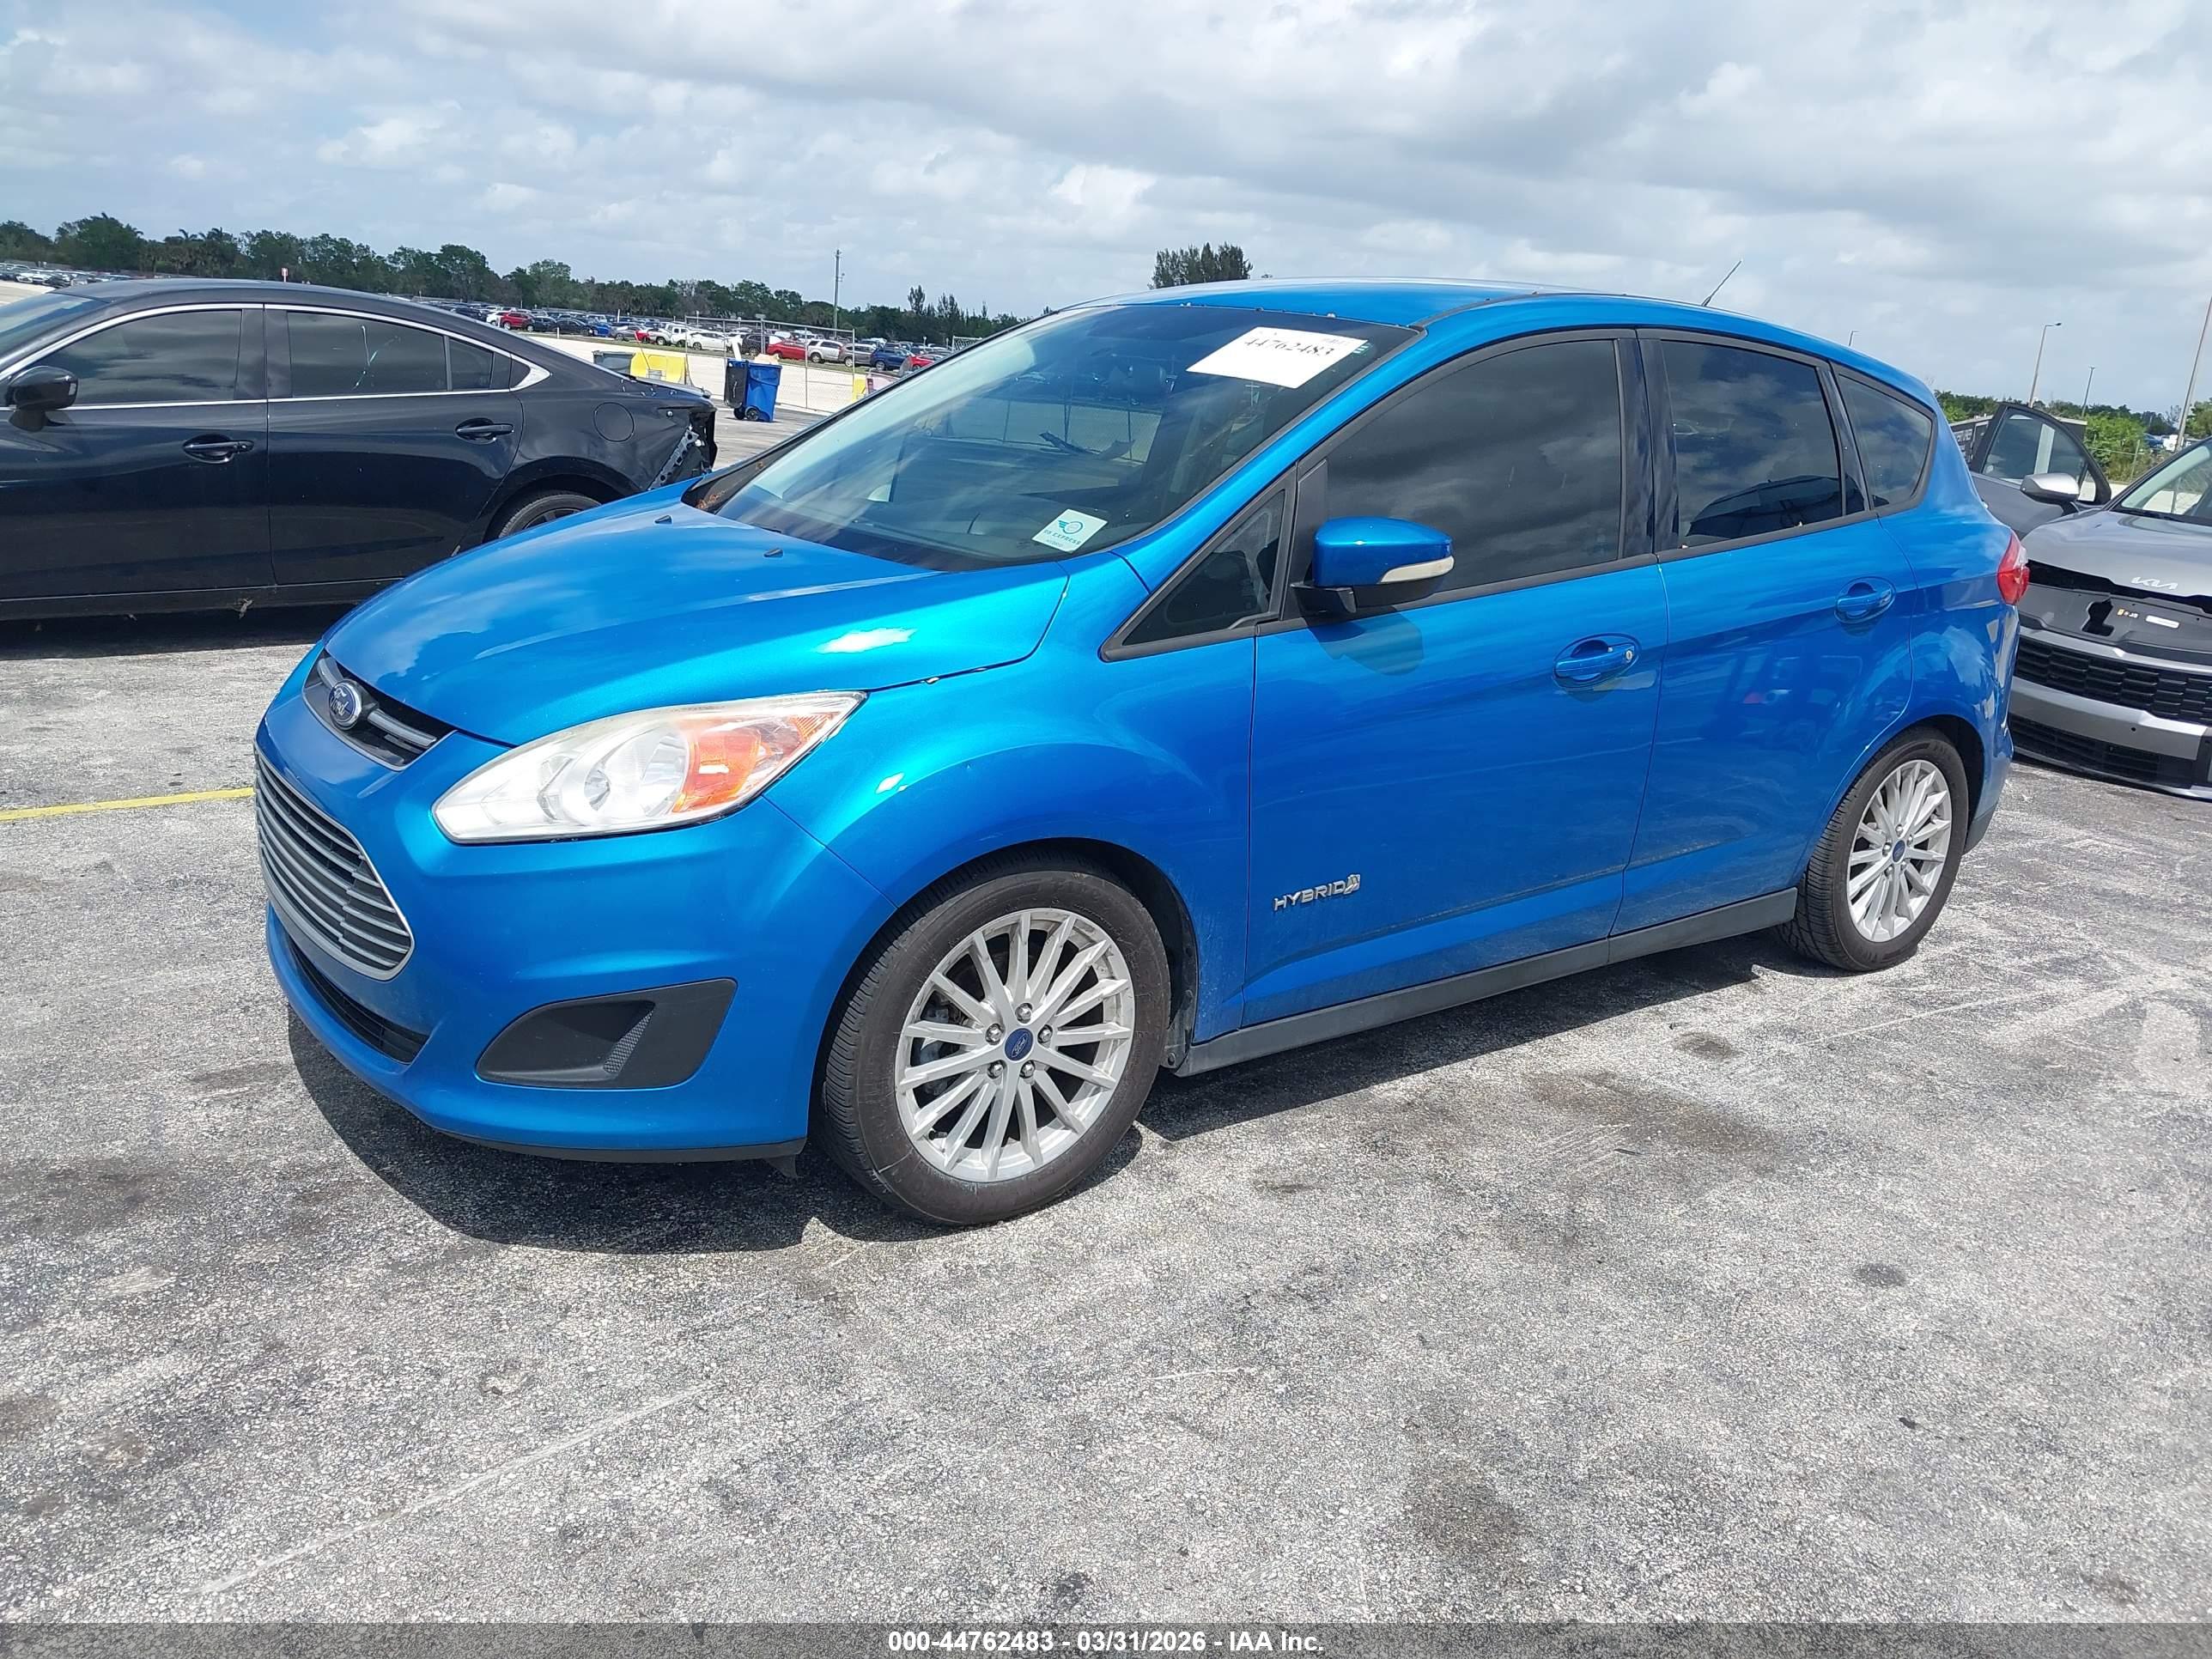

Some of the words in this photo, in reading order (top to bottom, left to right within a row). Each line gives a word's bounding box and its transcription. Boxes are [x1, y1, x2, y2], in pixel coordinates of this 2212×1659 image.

[1244, 337, 1335, 356] 44762483
[330, 688, 349, 716] Ford
[1273, 880, 1346, 911] HYBRID
